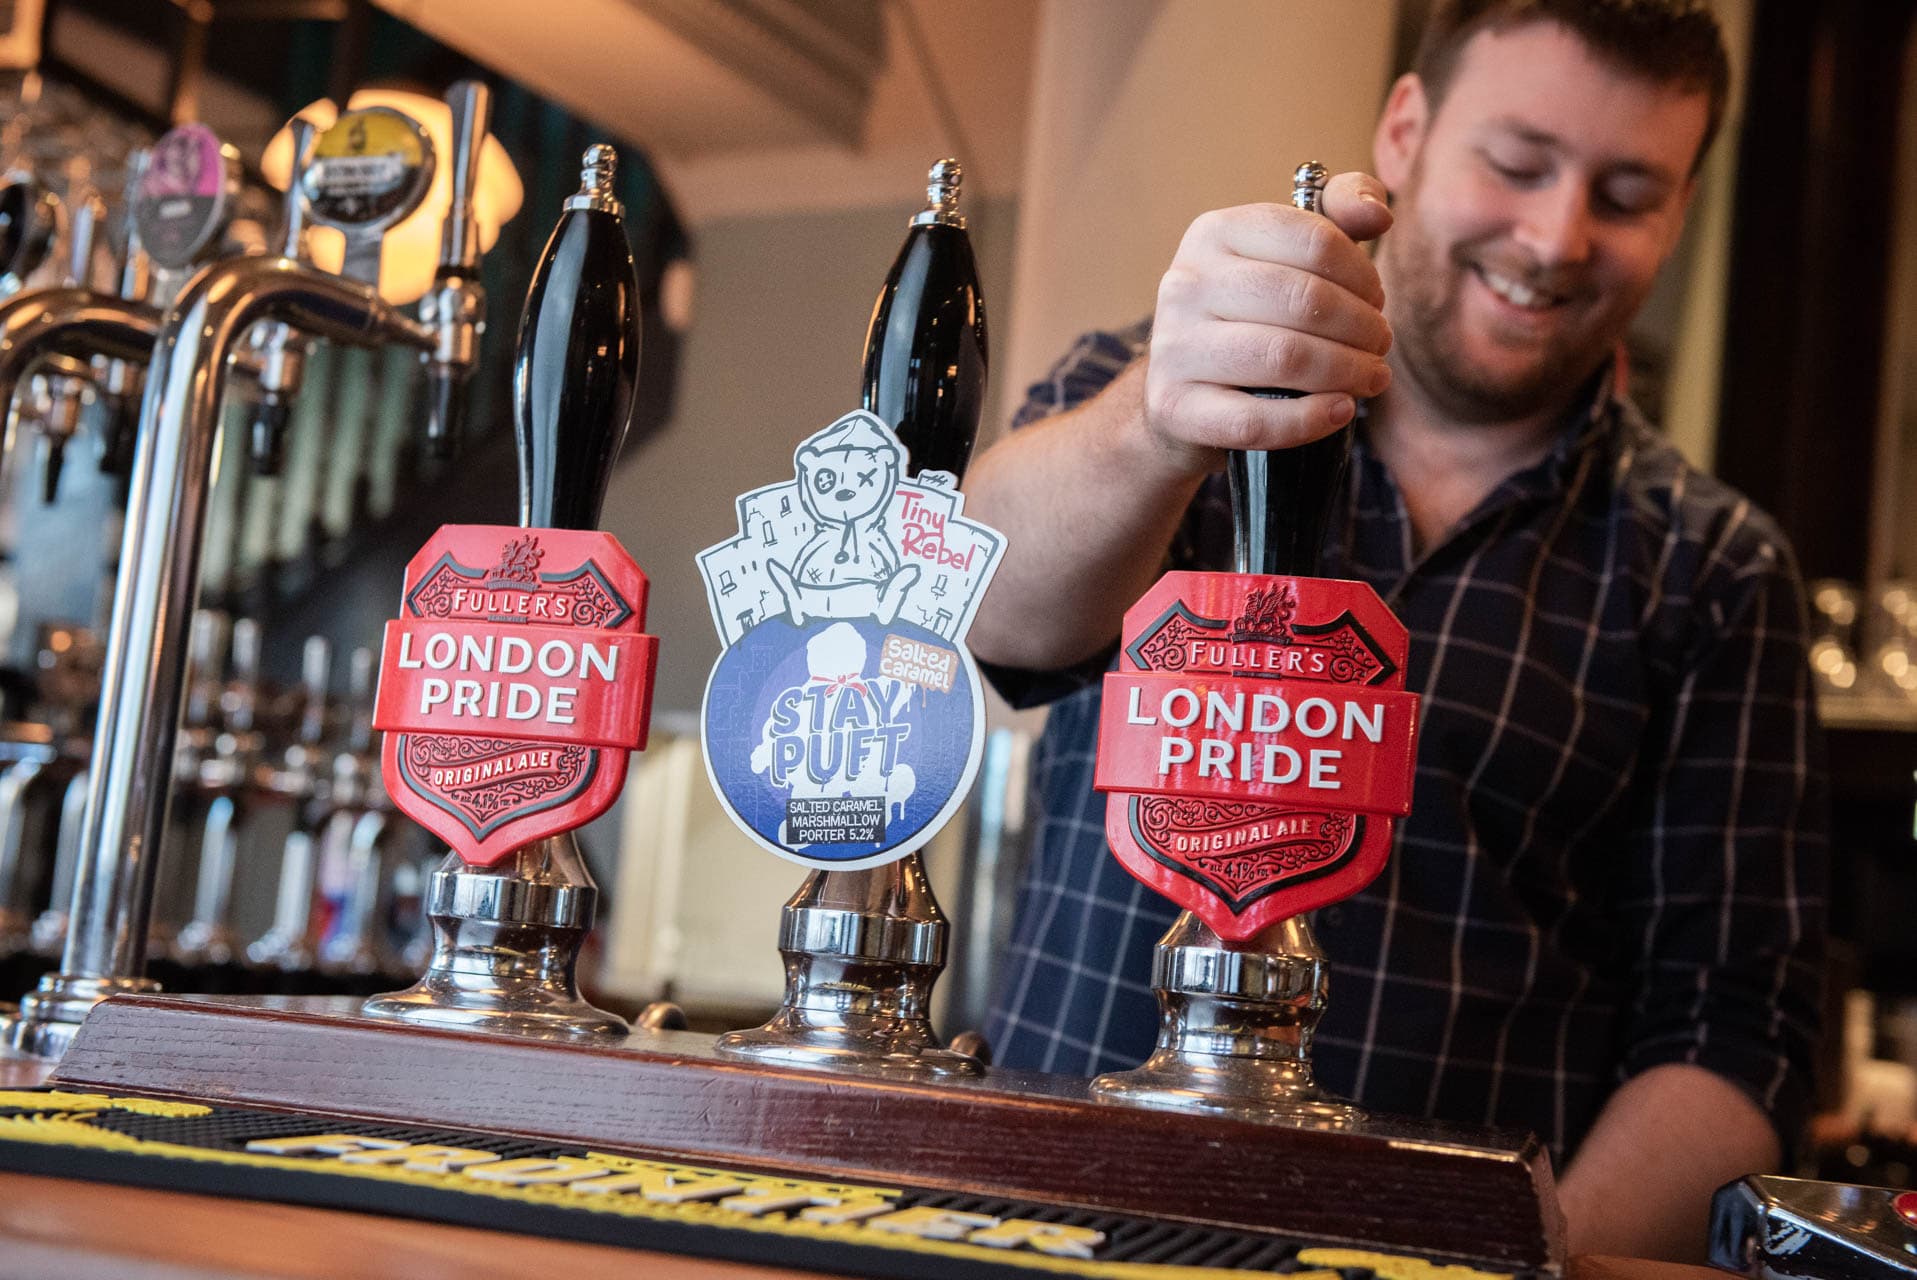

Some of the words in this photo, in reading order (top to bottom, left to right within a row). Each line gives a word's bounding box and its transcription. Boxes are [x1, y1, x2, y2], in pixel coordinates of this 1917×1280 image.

[896, 490, 945, 531] Tiny
[902, 522, 976, 572] Rebel
[453, 588, 568, 617] FULLER'S
[399, 632, 618, 681] LONDON
[888, 639, 951, 673] Salted
[1190, 641, 1325, 672] FULLER'S
[420, 677, 577, 724] PRIDE
[771, 680, 903, 738] STAY
[1127, 687, 1385, 743] LONDON
[434, 762, 513, 787] ORIGINAL
[518, 751, 551, 769] ALE
[771, 724, 911, 787] PUFT
[1158, 736, 1343, 790] PRIDE
[790, 801, 830, 814] SALTED
[833, 800, 882, 812] CARAMEL
[792, 814, 881, 828] MARSHMALLOW
[799, 829, 846, 841] PORTER
[849, 828, 875, 841] 5.2%
[1176, 829, 1273, 853] ORIGINAL
[1276, 819, 1312, 837] ALE
[1223, 861, 1255, 880] 4.1%
